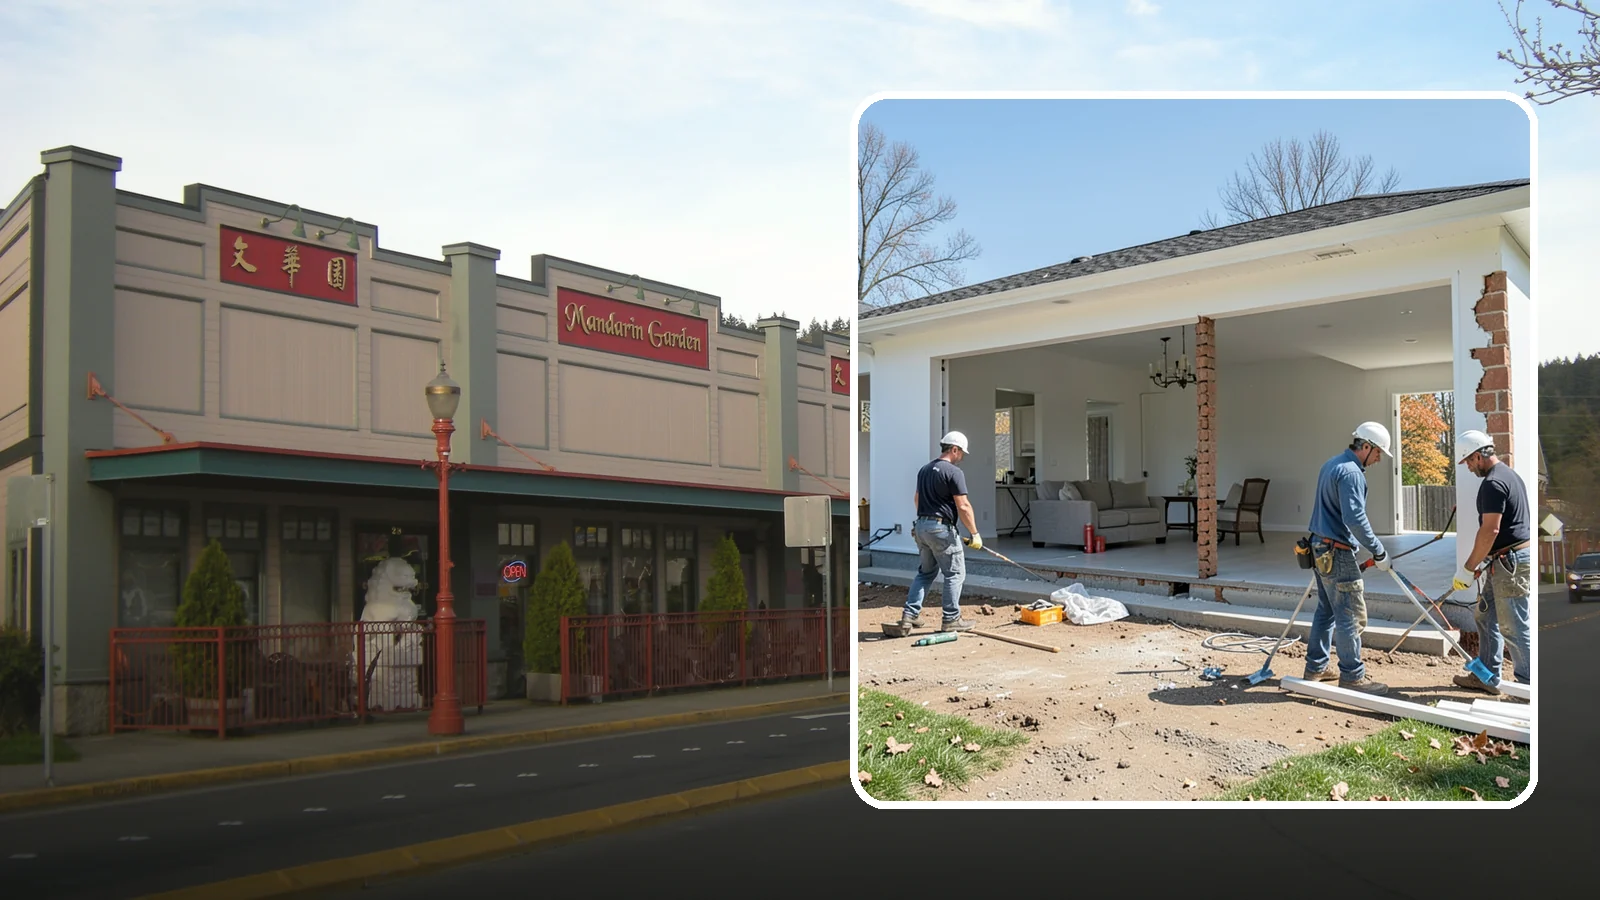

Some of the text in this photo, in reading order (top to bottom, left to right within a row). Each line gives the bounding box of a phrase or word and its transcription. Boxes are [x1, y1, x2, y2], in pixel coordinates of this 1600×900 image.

[231, 236, 346, 291] 文華園
[564, 302, 701, 352] Mandarin Garden
[835, 363, 847, 386] 文
[503, 565, 527, 578] OPEN
